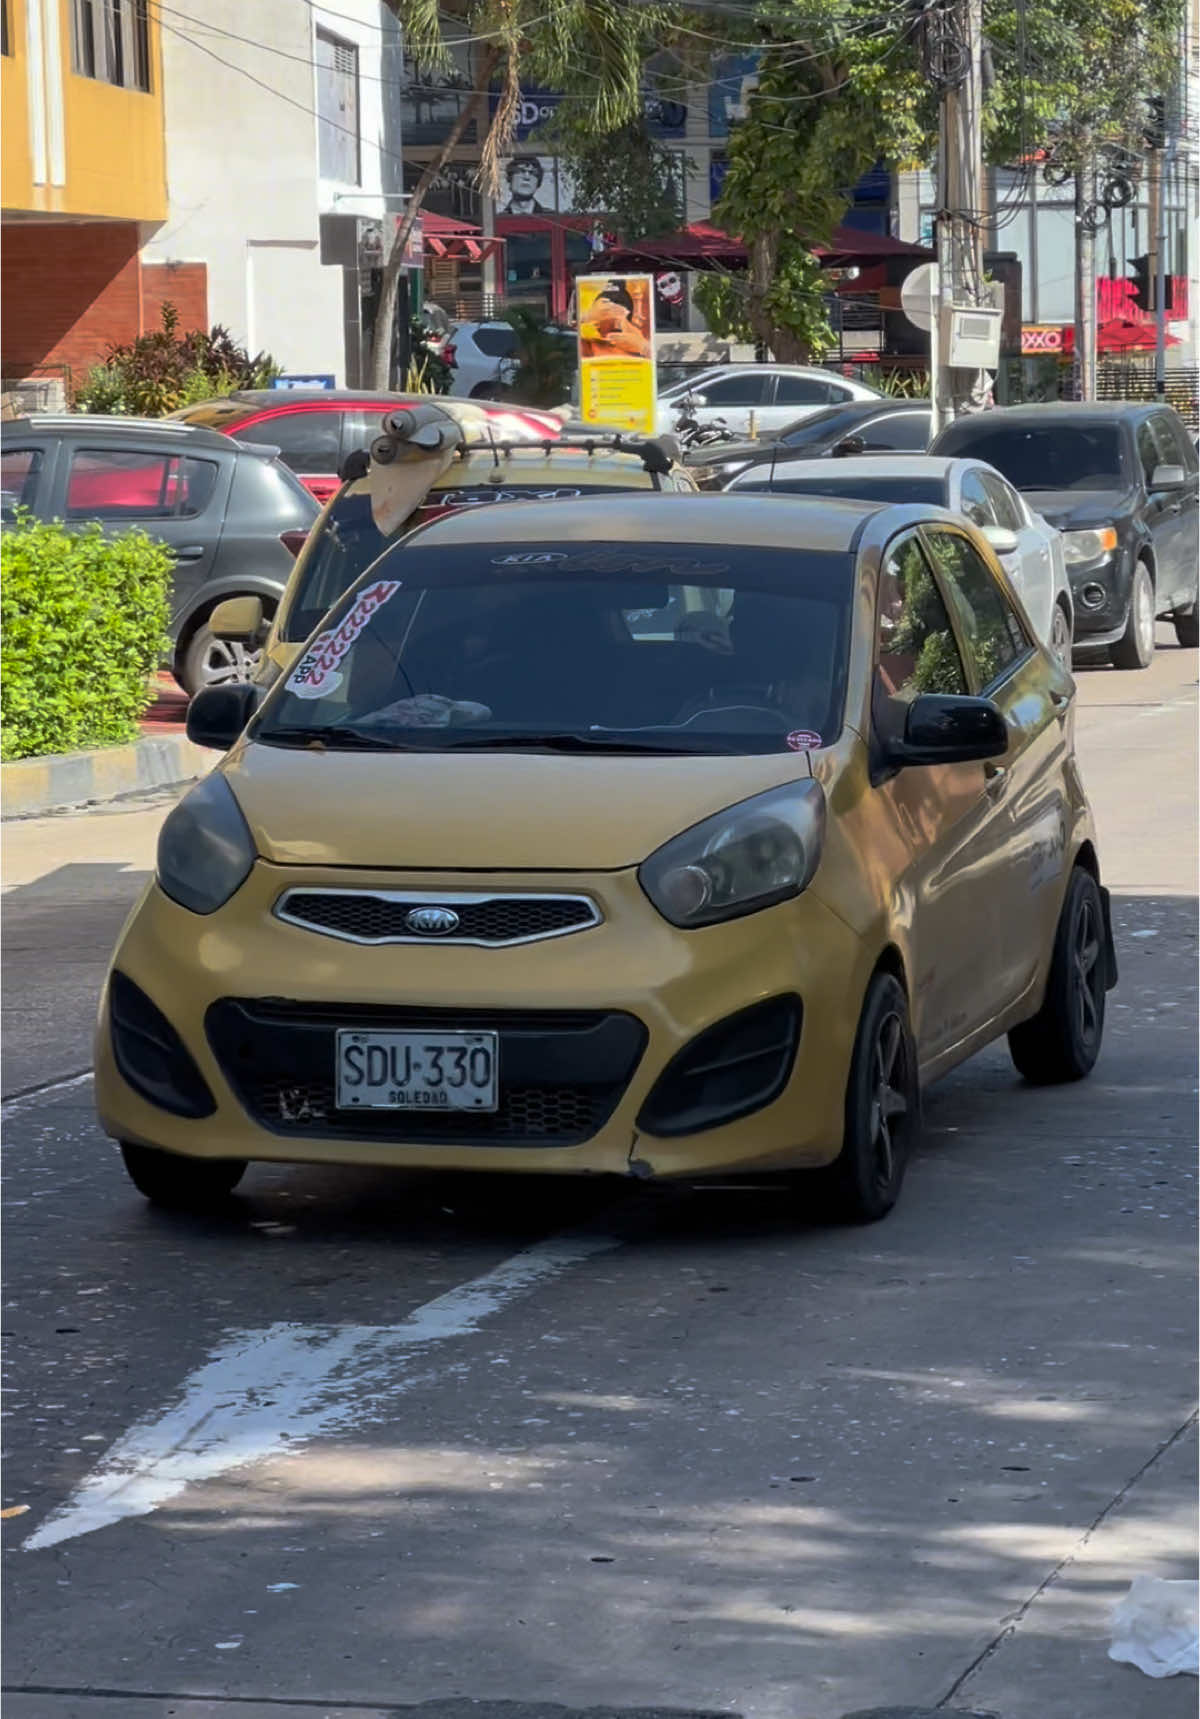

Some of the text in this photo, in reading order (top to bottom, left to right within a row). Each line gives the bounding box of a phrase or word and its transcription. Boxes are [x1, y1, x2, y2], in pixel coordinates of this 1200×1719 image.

[1021, 331, 1062, 348] XXO
[343, 1044, 491, 1088] SDU-330
[388, 1090, 449, 1104] SOLEDAD
